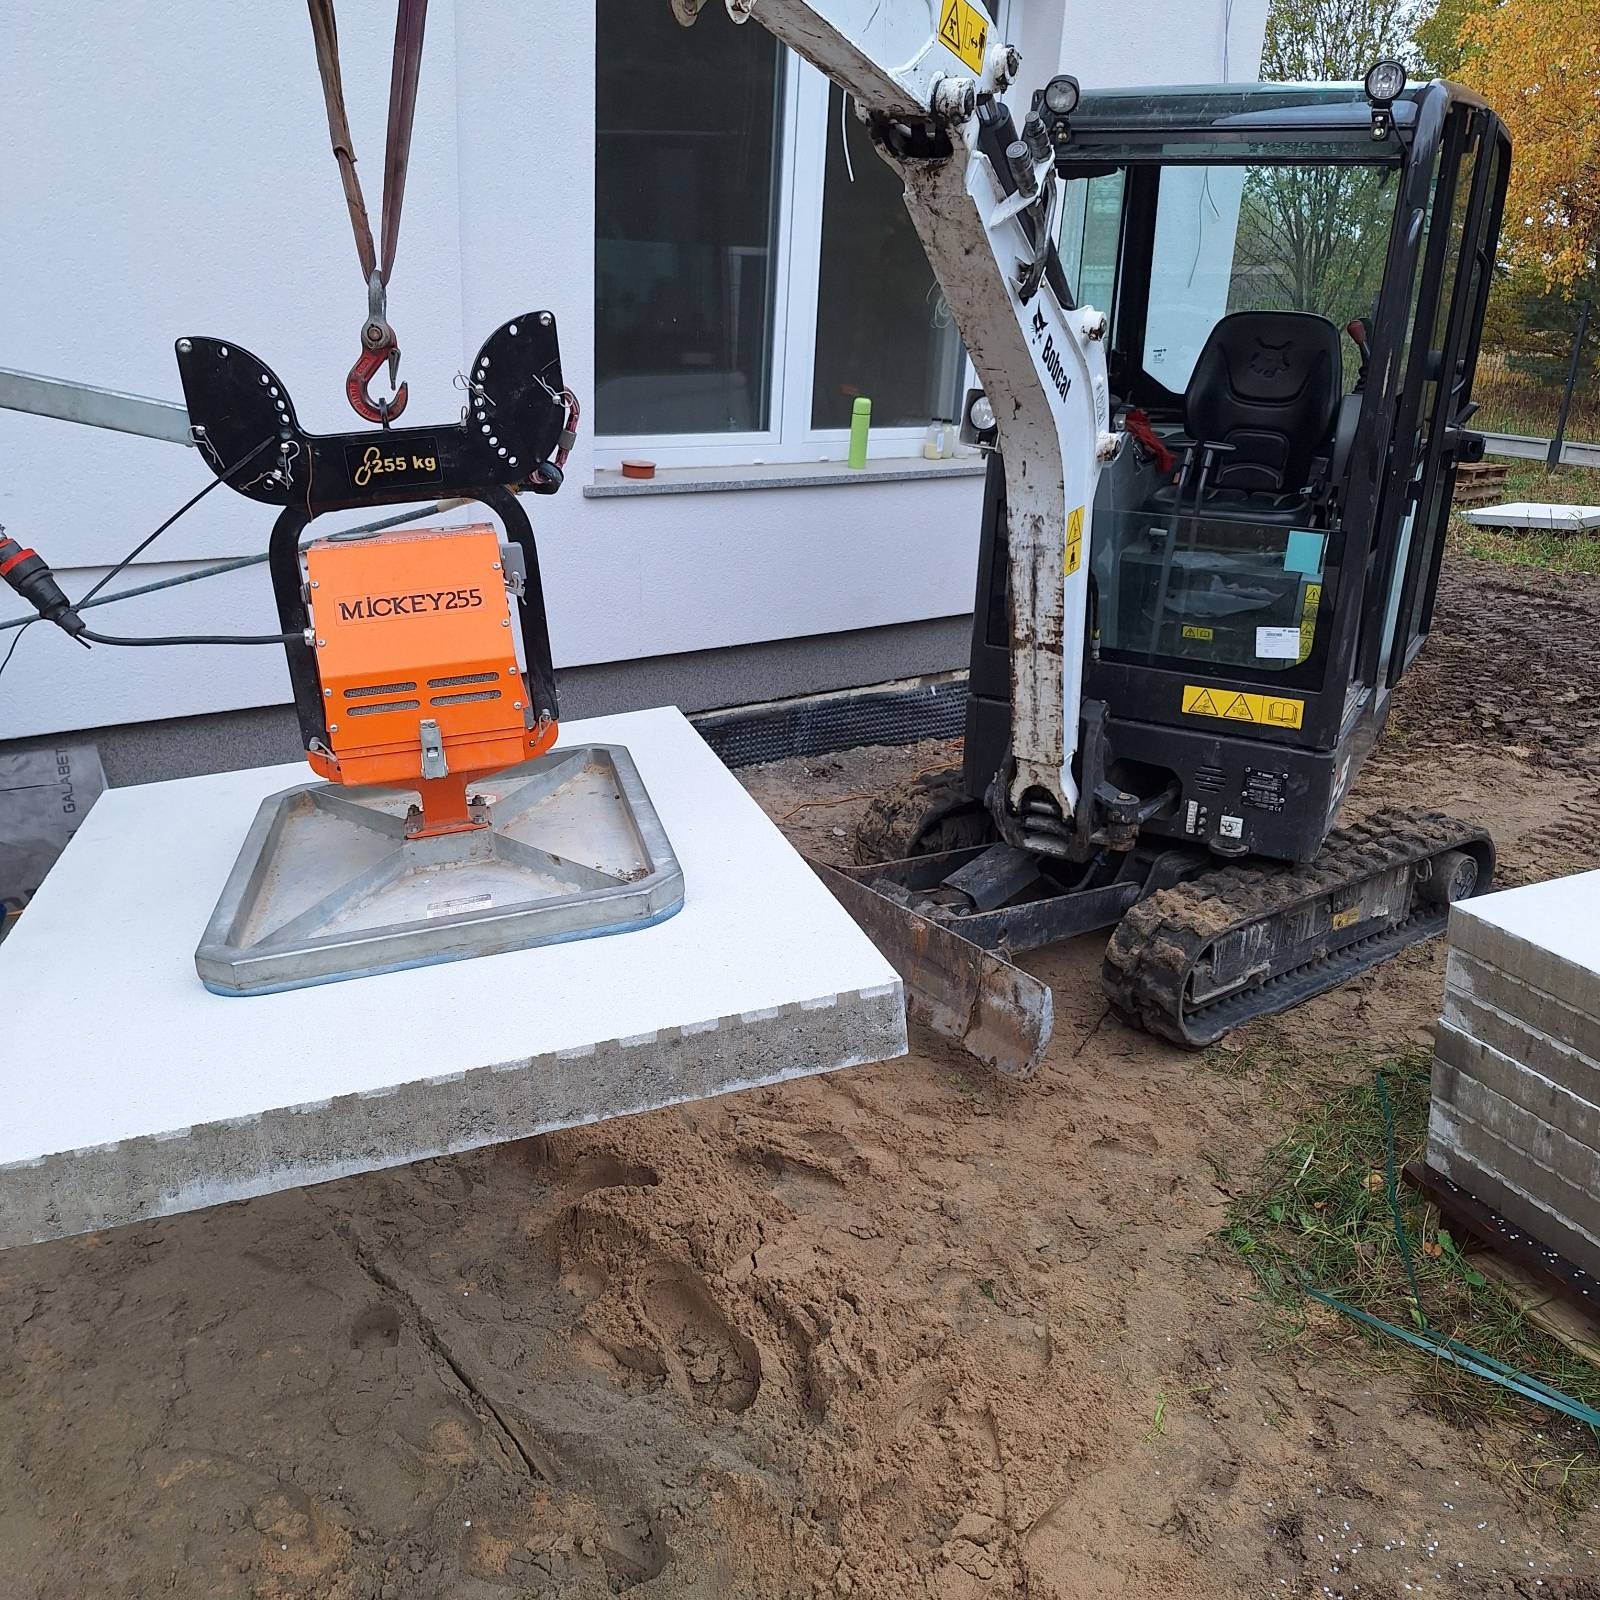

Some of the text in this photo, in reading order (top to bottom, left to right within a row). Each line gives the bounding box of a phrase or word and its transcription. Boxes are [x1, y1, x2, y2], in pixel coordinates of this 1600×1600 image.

[1042, 334, 1072, 403] Bobcat
[372, 455, 437, 474] 255 kg
[55, 749, 77, 814] GALABET
